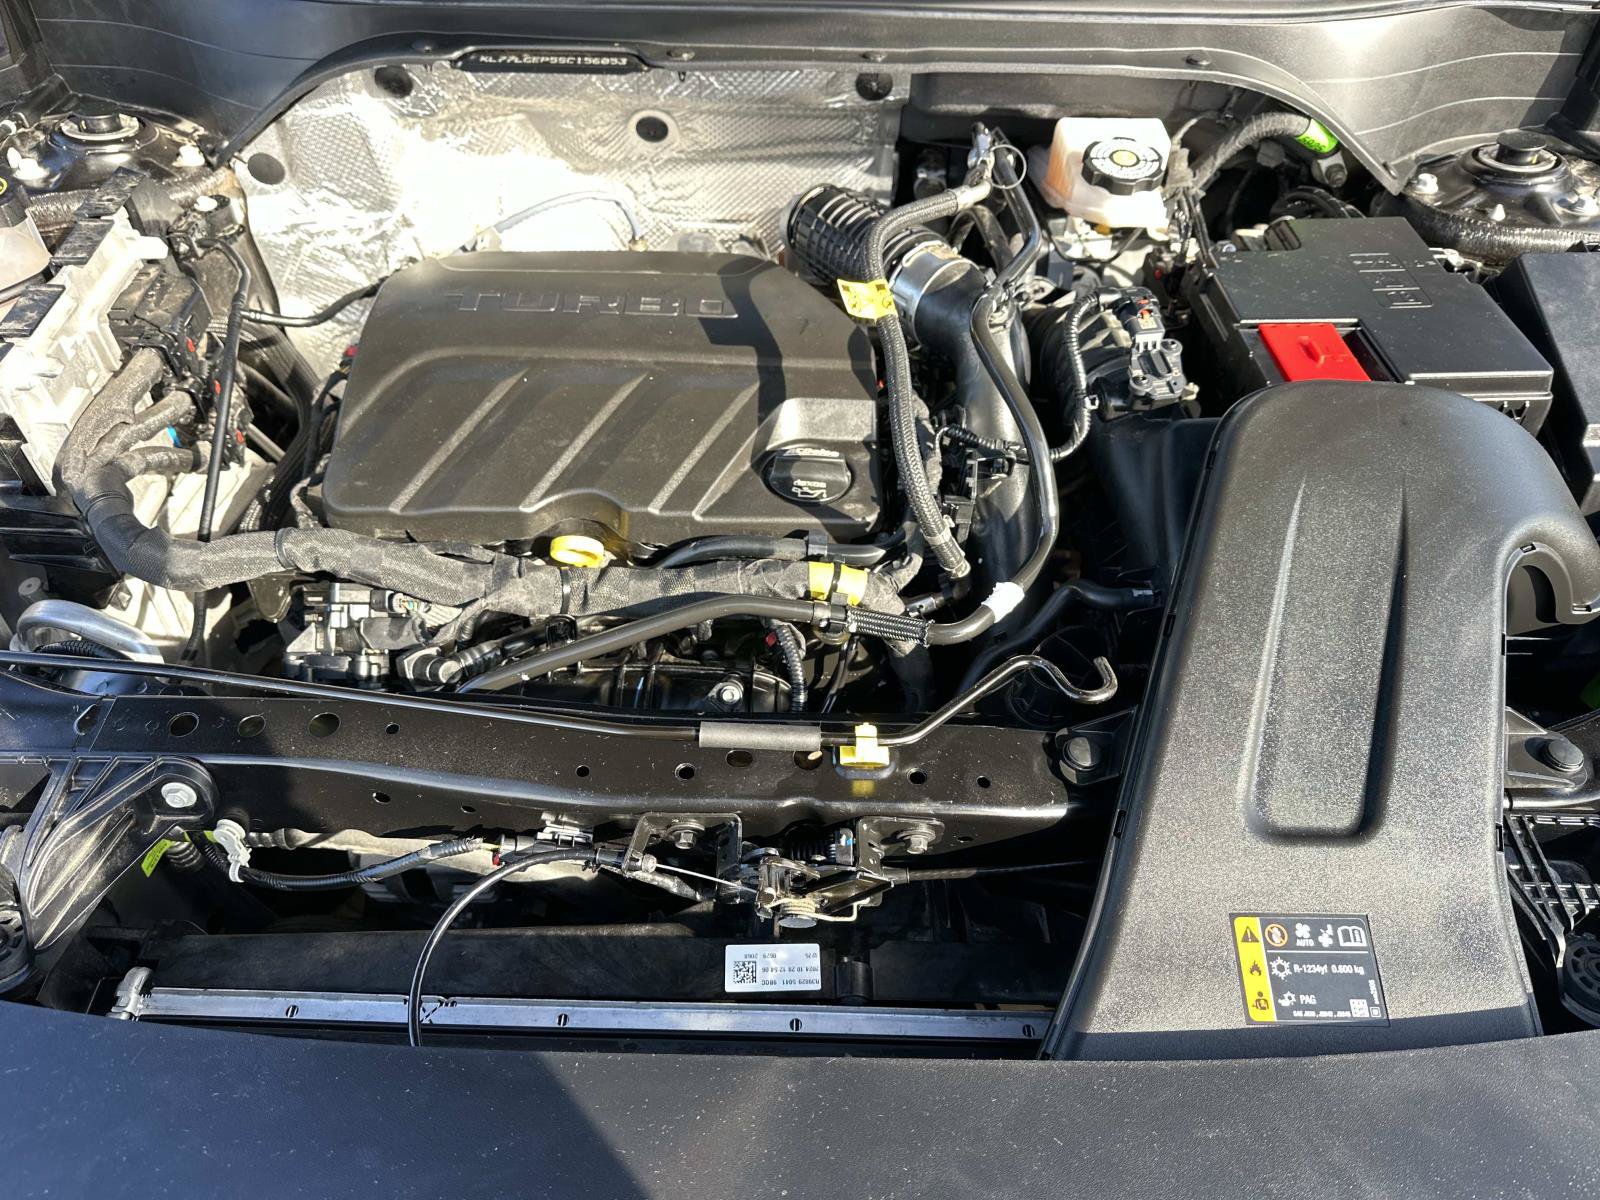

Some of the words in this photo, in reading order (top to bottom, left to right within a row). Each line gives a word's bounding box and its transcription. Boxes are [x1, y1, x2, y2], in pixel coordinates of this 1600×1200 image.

[479, 55, 628, 65] KL77LGEP5SC156053
[441, 292, 738, 319] TURBO
[1293, 964, 1328, 975] R-1234yf
[1353, 964, 1365, 975] kg
[1300, 994, 1317, 1005] PAG
